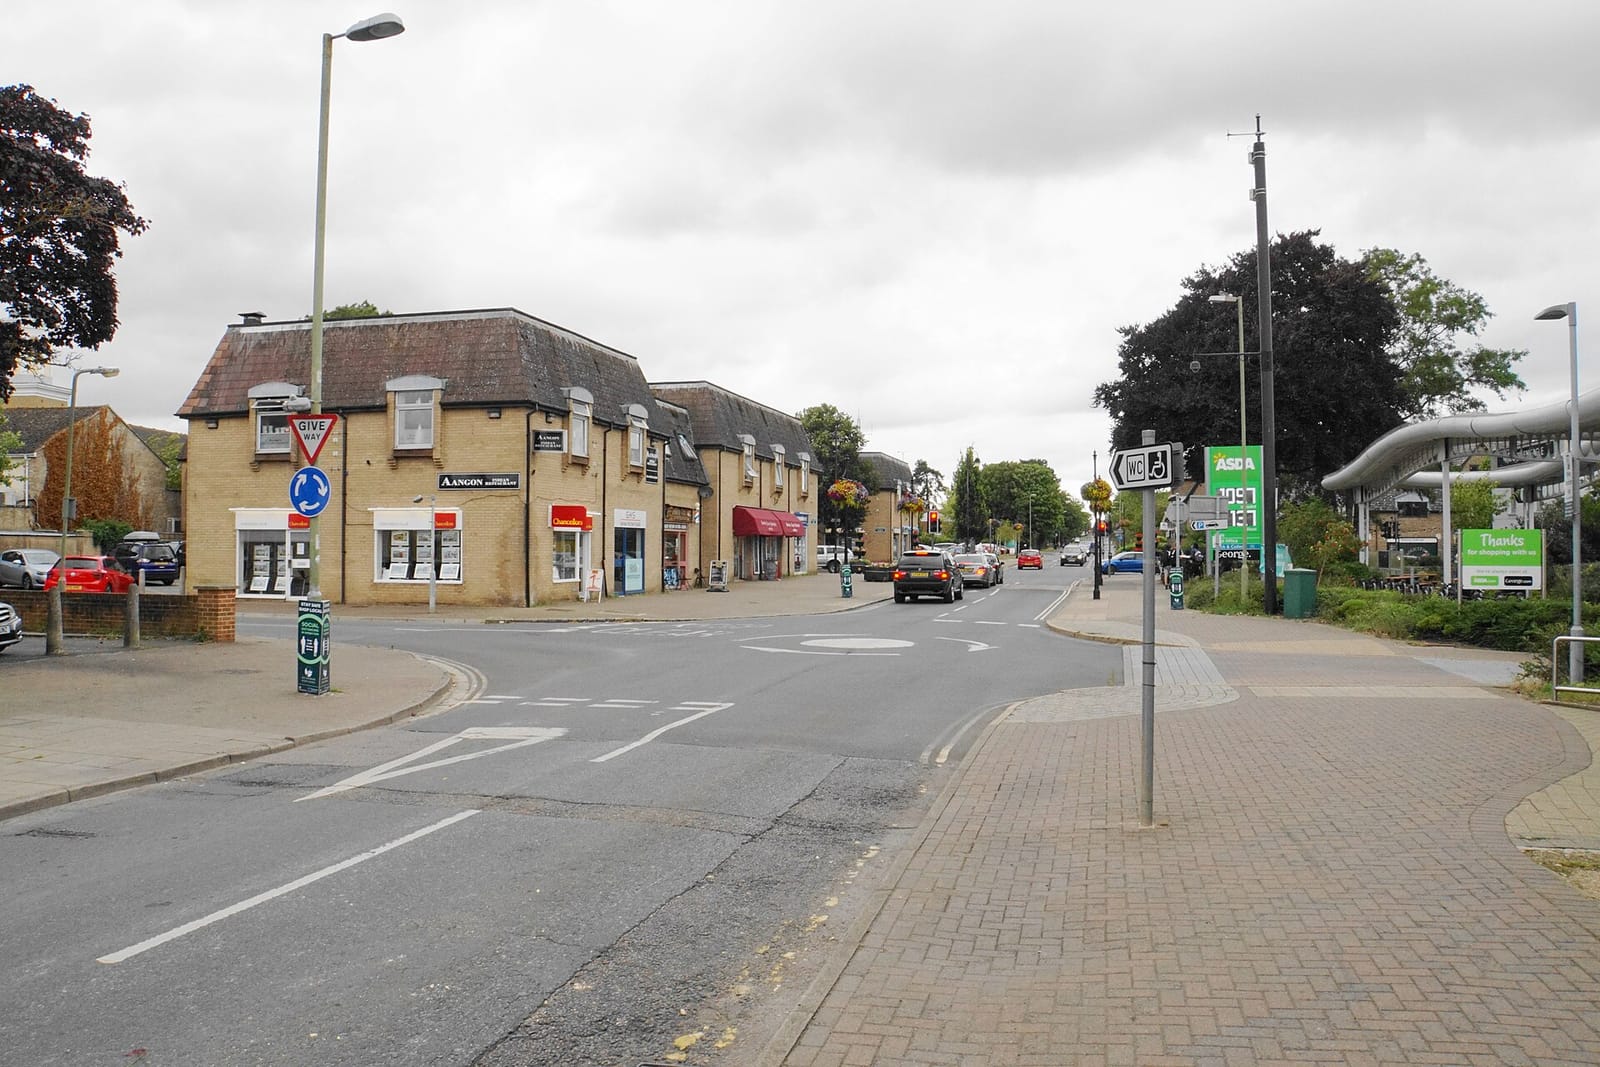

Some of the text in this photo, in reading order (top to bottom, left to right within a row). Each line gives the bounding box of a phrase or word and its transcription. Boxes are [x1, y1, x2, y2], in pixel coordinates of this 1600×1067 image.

[298, 421, 326, 431] GIVE
[1129, 460, 1143, 475] WC
[1216, 458, 1255, 470] ASDA
[441, 477, 483, 486] AANGON
[1480, 533, 1524, 547] Thanks
